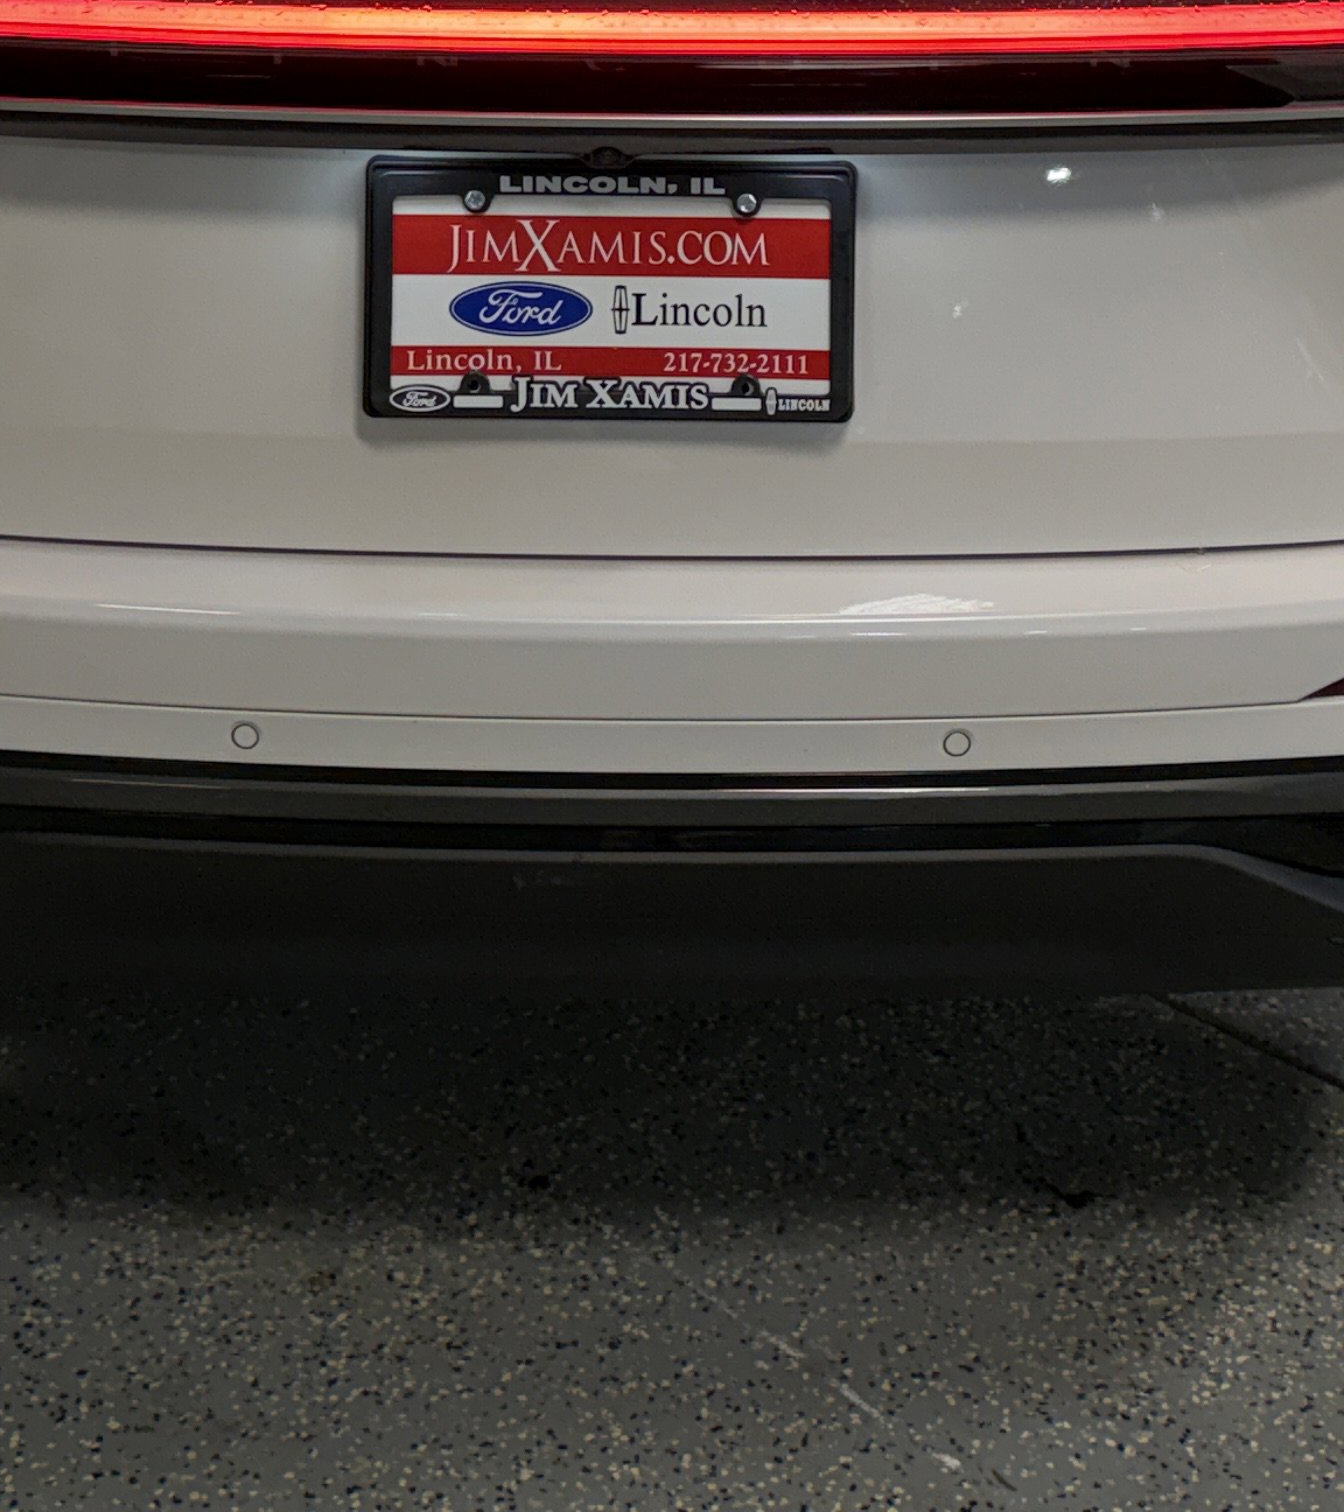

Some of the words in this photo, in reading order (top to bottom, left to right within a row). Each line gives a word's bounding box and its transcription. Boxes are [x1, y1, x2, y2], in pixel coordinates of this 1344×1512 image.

[499, 175, 679, 195] LINCOLN,
[690, 176, 726, 196] IL
[447, 219, 771, 274] JIMXAMIS.COM
[478, 288, 564, 327] Ford
[631, 292, 768, 328] Lincoln
[407, 349, 522, 373] Lincoln,
[534, 350, 562, 370] IL
[663, 352, 808, 375] 217-732-2111
[402, 391, 437, 407] Ford
[510, 376, 579, 413] JIM
[586, 380, 709, 411] XAMIS
[778, 399, 830, 411] LINCOLN
